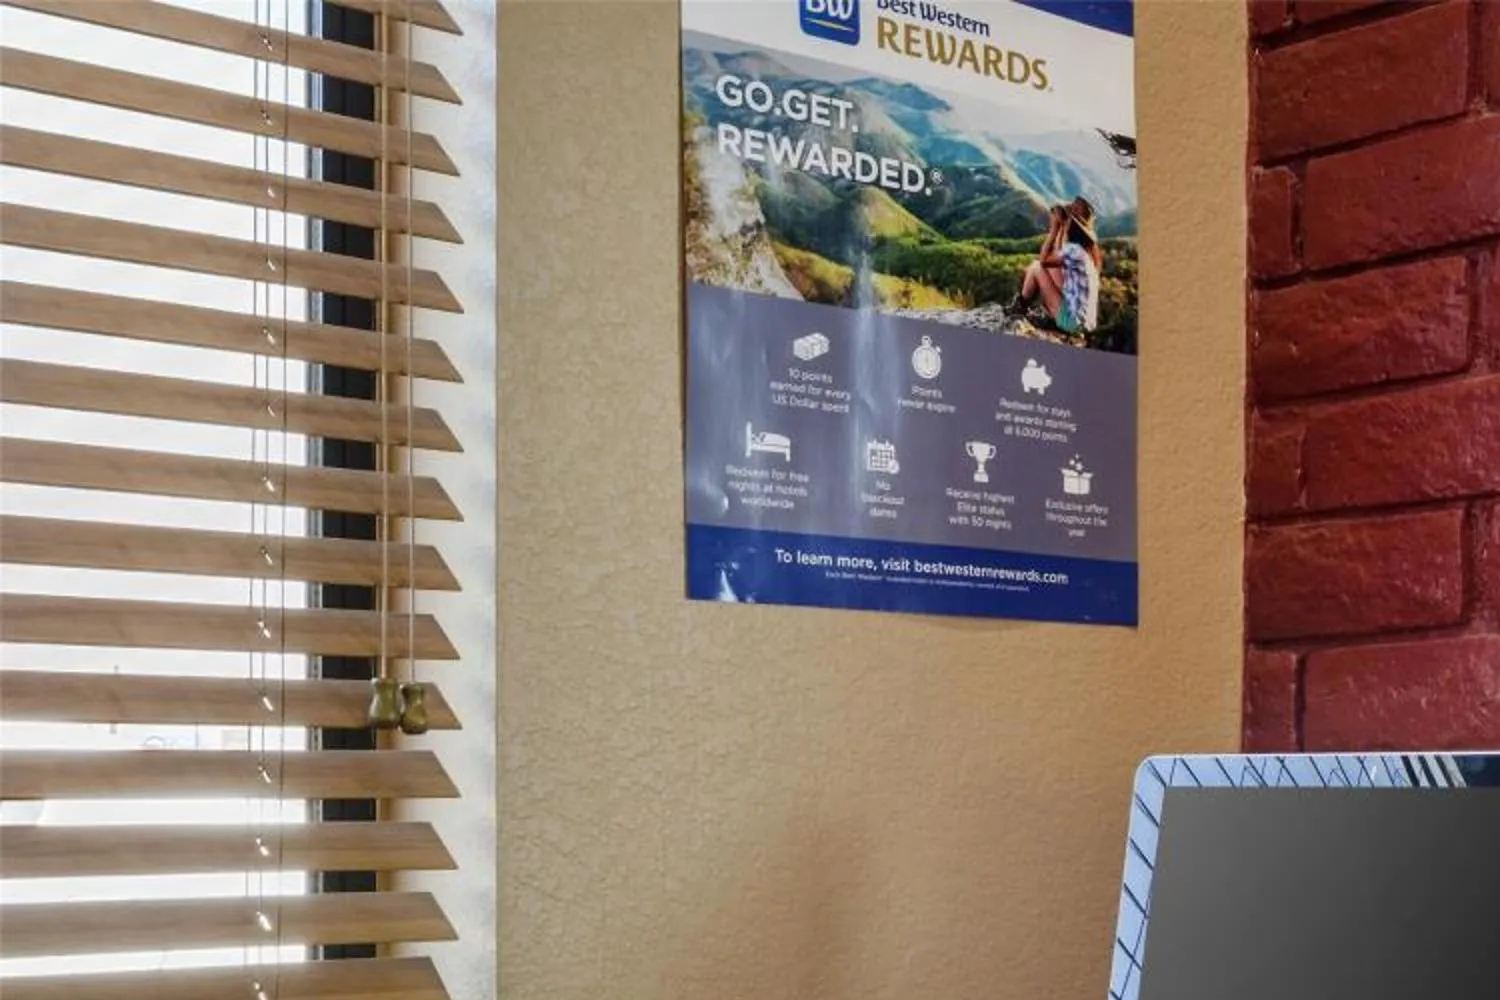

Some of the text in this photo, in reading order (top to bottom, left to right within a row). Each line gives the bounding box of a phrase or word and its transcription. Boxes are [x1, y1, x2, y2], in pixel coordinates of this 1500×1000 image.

[920, 3, 990, 37] Western
[772, 395, 787, 406] US
[789, 396, 820, 409] Dollar
[775, 549, 793, 563] To
[796, 551, 833, 567] learn
[837, 555, 877, 571] more,
[881, 557, 910, 572] visit
[914, 559, 1069, 586] bestwesternrewards.com
